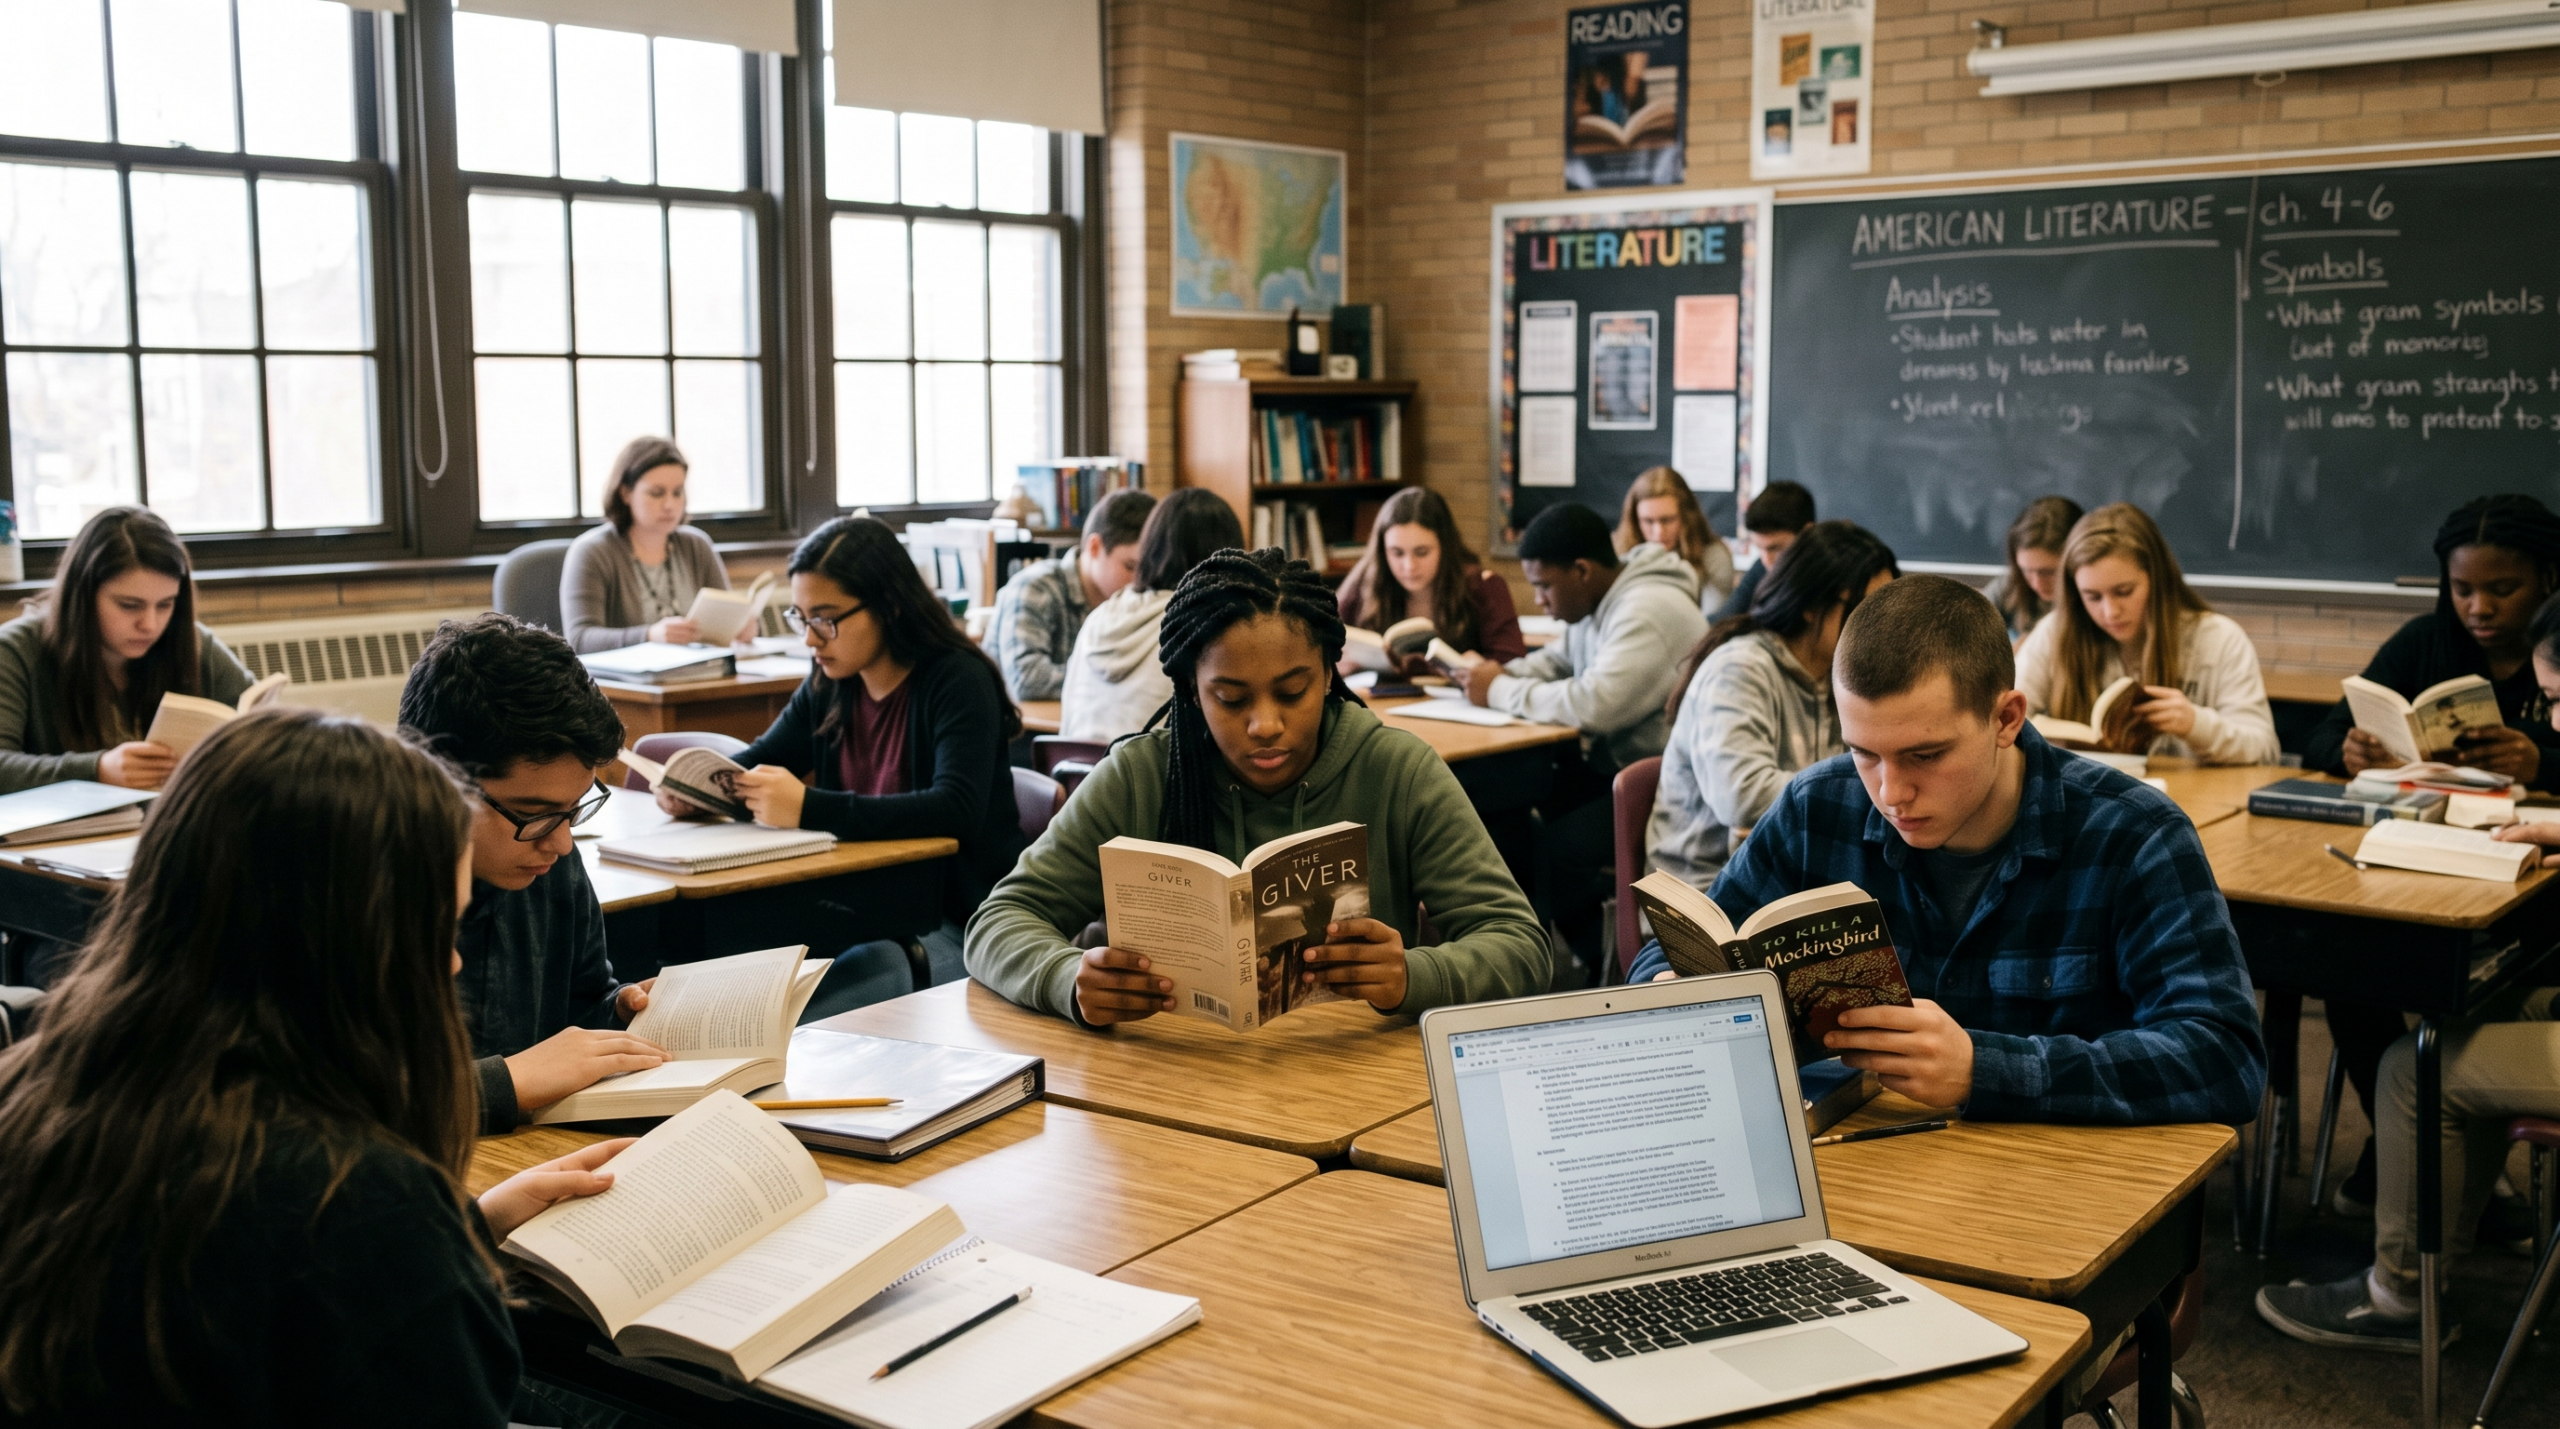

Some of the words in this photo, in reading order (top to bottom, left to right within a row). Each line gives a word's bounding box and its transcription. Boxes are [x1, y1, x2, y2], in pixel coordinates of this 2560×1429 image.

[1571, 4, 1683, 44] READING
[1852, 209, 2004, 256] AMERICAN
[2024, 194, 2214, 241] LITERATURE
[2260, 192, 2307, 226] ch.
[1529, 226, 1726, 271] LITERATURE
[2260, 249, 2384, 297] Symbols
[1885, 275, 1993, 320] Analysis
[2277, 299, 2345, 328] What
[2358, 303, 2422, 336] gram
[2433, 286, 2545, 331] symbols
[2347, 333, 2371, 357] of
[2276, 371, 2344, 400] What
[2356, 379, 2422, 411] gram
[2514, 406, 2543, 430] to
[1148, 872, 1192, 888] GIVER
[1292, 853, 1320, 869] THE
[1261, 859, 1358, 906] GIVER
[1761, 935, 1786, 951] TO
[1796, 920, 1841, 940] KILL
[1850, 915, 1863, 926] A
[1764, 924, 1880, 971] Mockingbird
